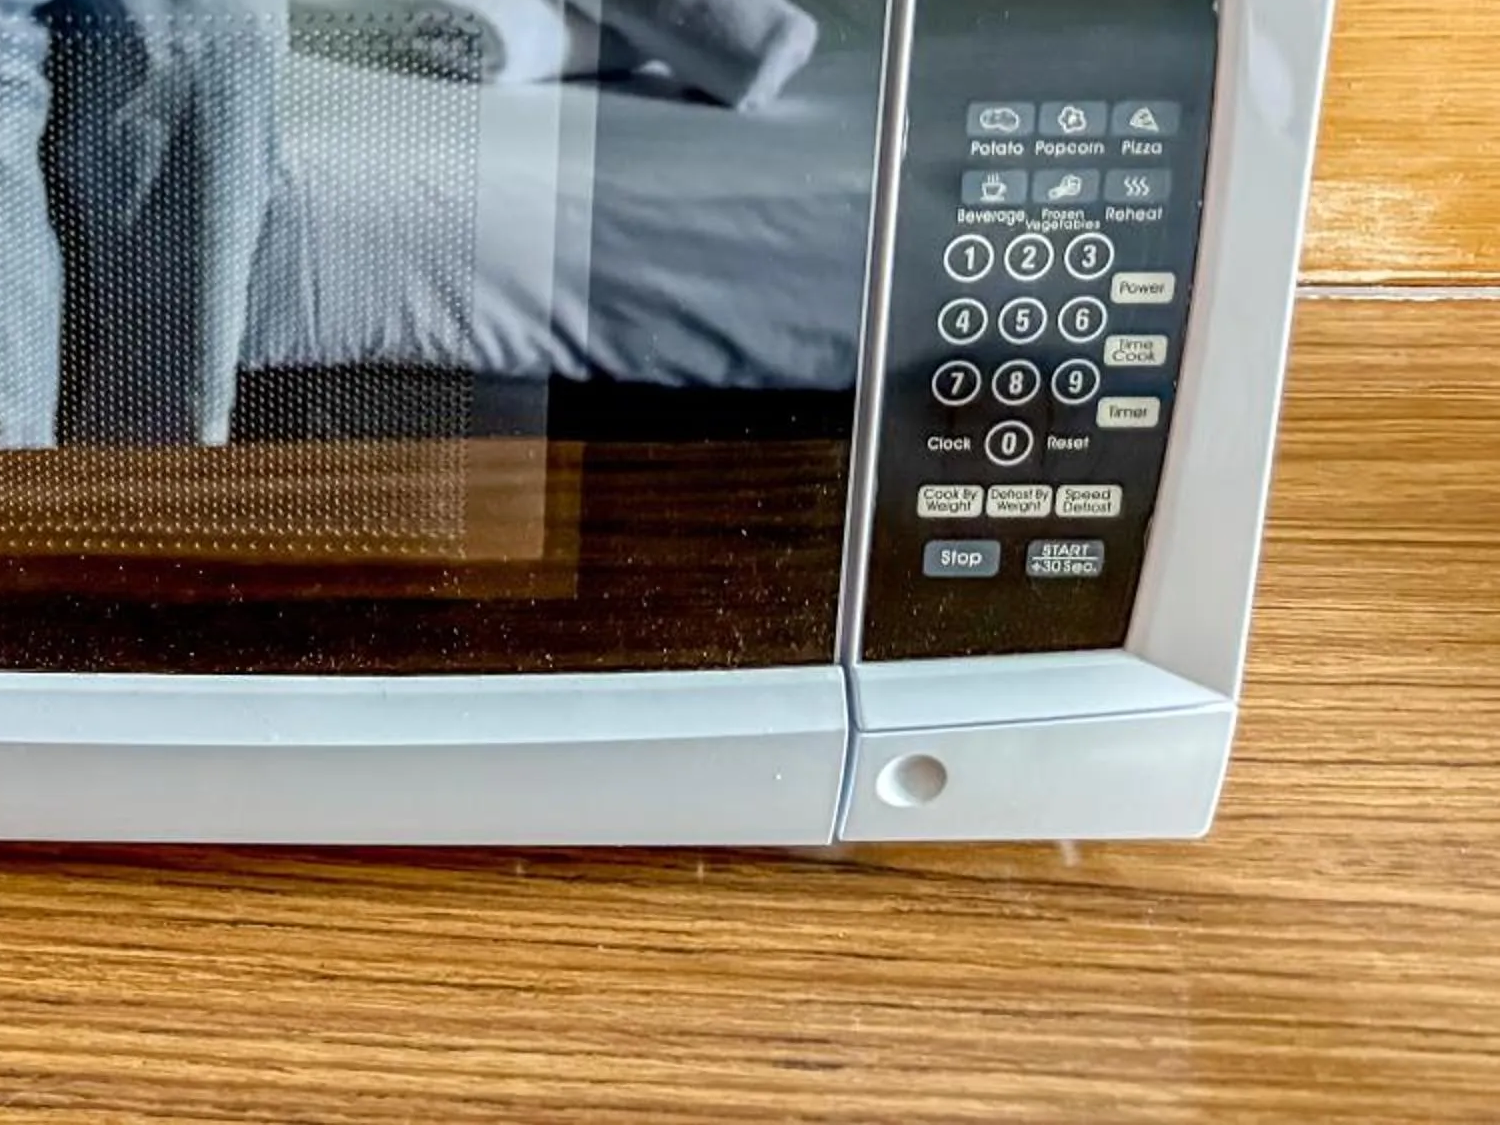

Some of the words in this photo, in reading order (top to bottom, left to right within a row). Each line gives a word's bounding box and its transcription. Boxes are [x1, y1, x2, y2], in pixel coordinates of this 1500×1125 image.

[970, 140, 1024, 156] Potato
[1035, 140, 1105, 157] Popcorn
[1121, 140, 1163, 155] Pizza
[957, 208, 1026, 226] Beverage
[1042, 208, 1084, 221] Frozen
[1105, 207, 1163, 222] Reheat
[1026, 219, 1100, 232] Vegetables
[964, 246, 976, 271] 1
[1021, 246, 1037, 270] 2
[1081, 244, 1098, 269] 3
[1119, 280, 1165, 294] Power
[955, 310, 970, 334] 4
[1015, 309, 1030, 332] 5
[1074, 307, 1090, 331] 6
[1119, 339, 1153, 350] Time
[1112, 350, 1155, 362] Cook
[950, 372, 965, 396] 7
[1008, 371, 1023, 395] 8
[1068, 370, 1084, 394] 9
[1108, 405, 1148, 419] Timer
[927, 436, 971, 451] Clock
[1001, 432, 1017, 456] 0
[1047, 435, 1090, 451] Reset
[923, 488, 960, 500] Cook
[963, 489, 978, 502] By
[991, 488, 1032, 500] Defrost
[1035, 489, 1049, 502] By
[1065, 488, 1111, 502] Speed
[927, 500, 971, 513] Weight
[997, 500, 1042, 513] Weight
[1063, 501, 1112, 513] Defrost
[1042, 544, 1088, 556] START
[941, 550, 982, 568] Stop
